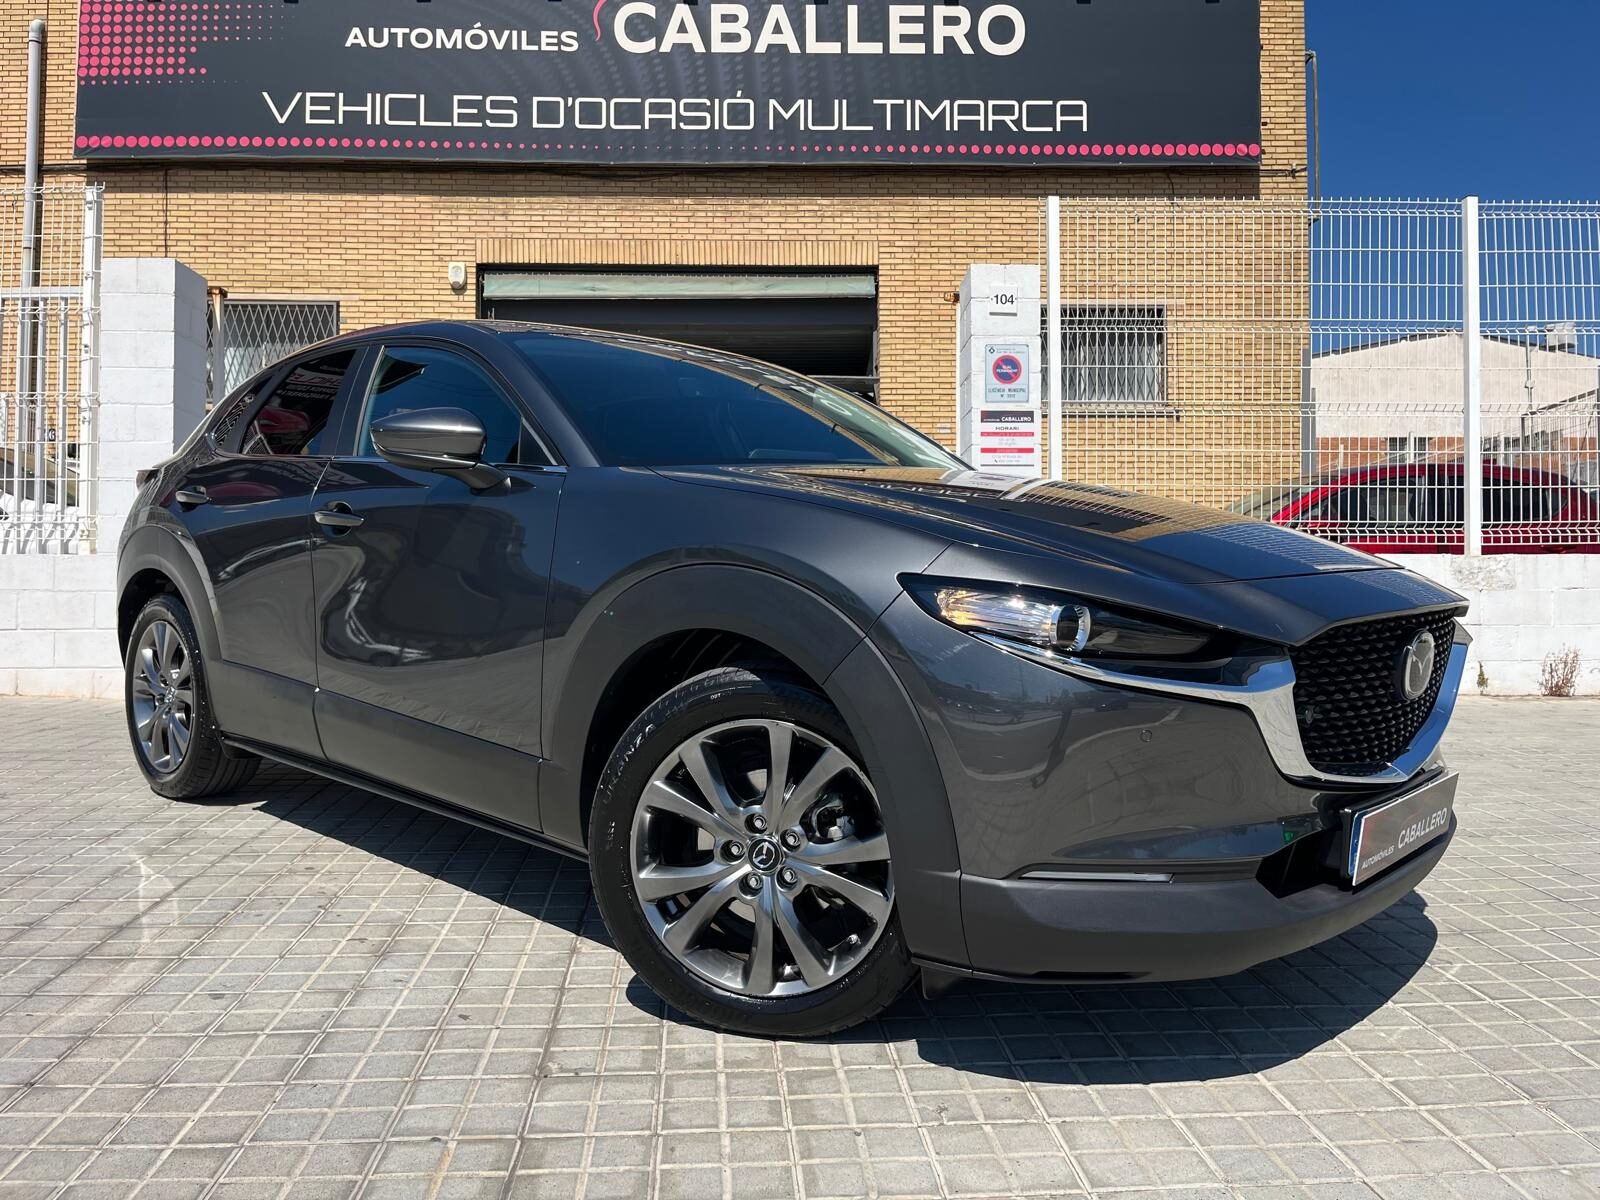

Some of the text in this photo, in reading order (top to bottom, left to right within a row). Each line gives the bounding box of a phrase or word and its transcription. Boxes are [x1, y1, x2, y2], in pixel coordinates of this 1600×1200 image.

[344, 1, 1026, 56] AUTOMÓVILES CABALLERO
[261, 90, 1089, 132] VEHICLES D'OCASIÓ MULTIMARCA
[993, 293, 1015, 305] 104
[1361, 807, 1448, 869] AUTOMÓVILES CABALLERO
